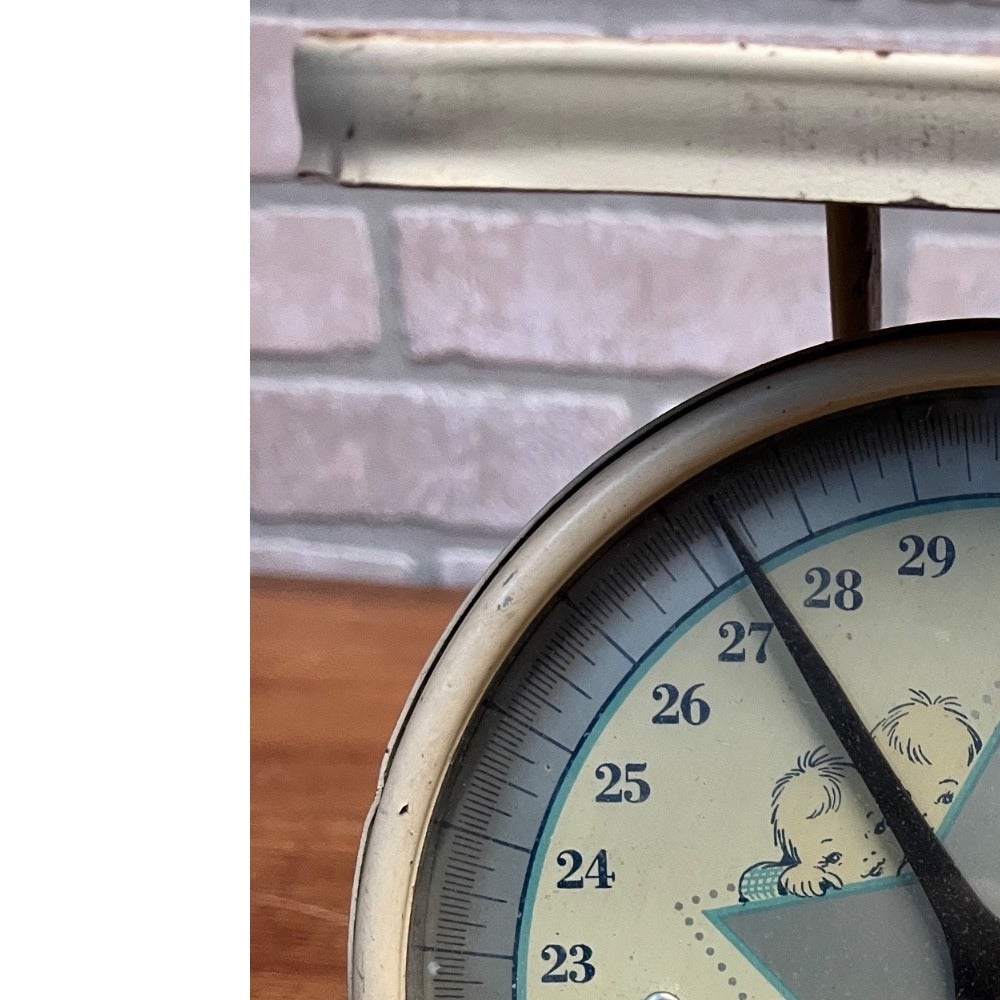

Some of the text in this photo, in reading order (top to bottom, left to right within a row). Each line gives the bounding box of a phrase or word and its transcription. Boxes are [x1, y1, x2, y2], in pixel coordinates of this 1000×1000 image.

[898, 536, 955, 578] 29
[805, 568, 863, 611] 28
[719, 622, 772, 663] 27
[652, 683, 710, 725] 26
[596, 763, 650, 803] 25
[557, 849, 615, 889] 24
[541, 944, 595, 983] 23
